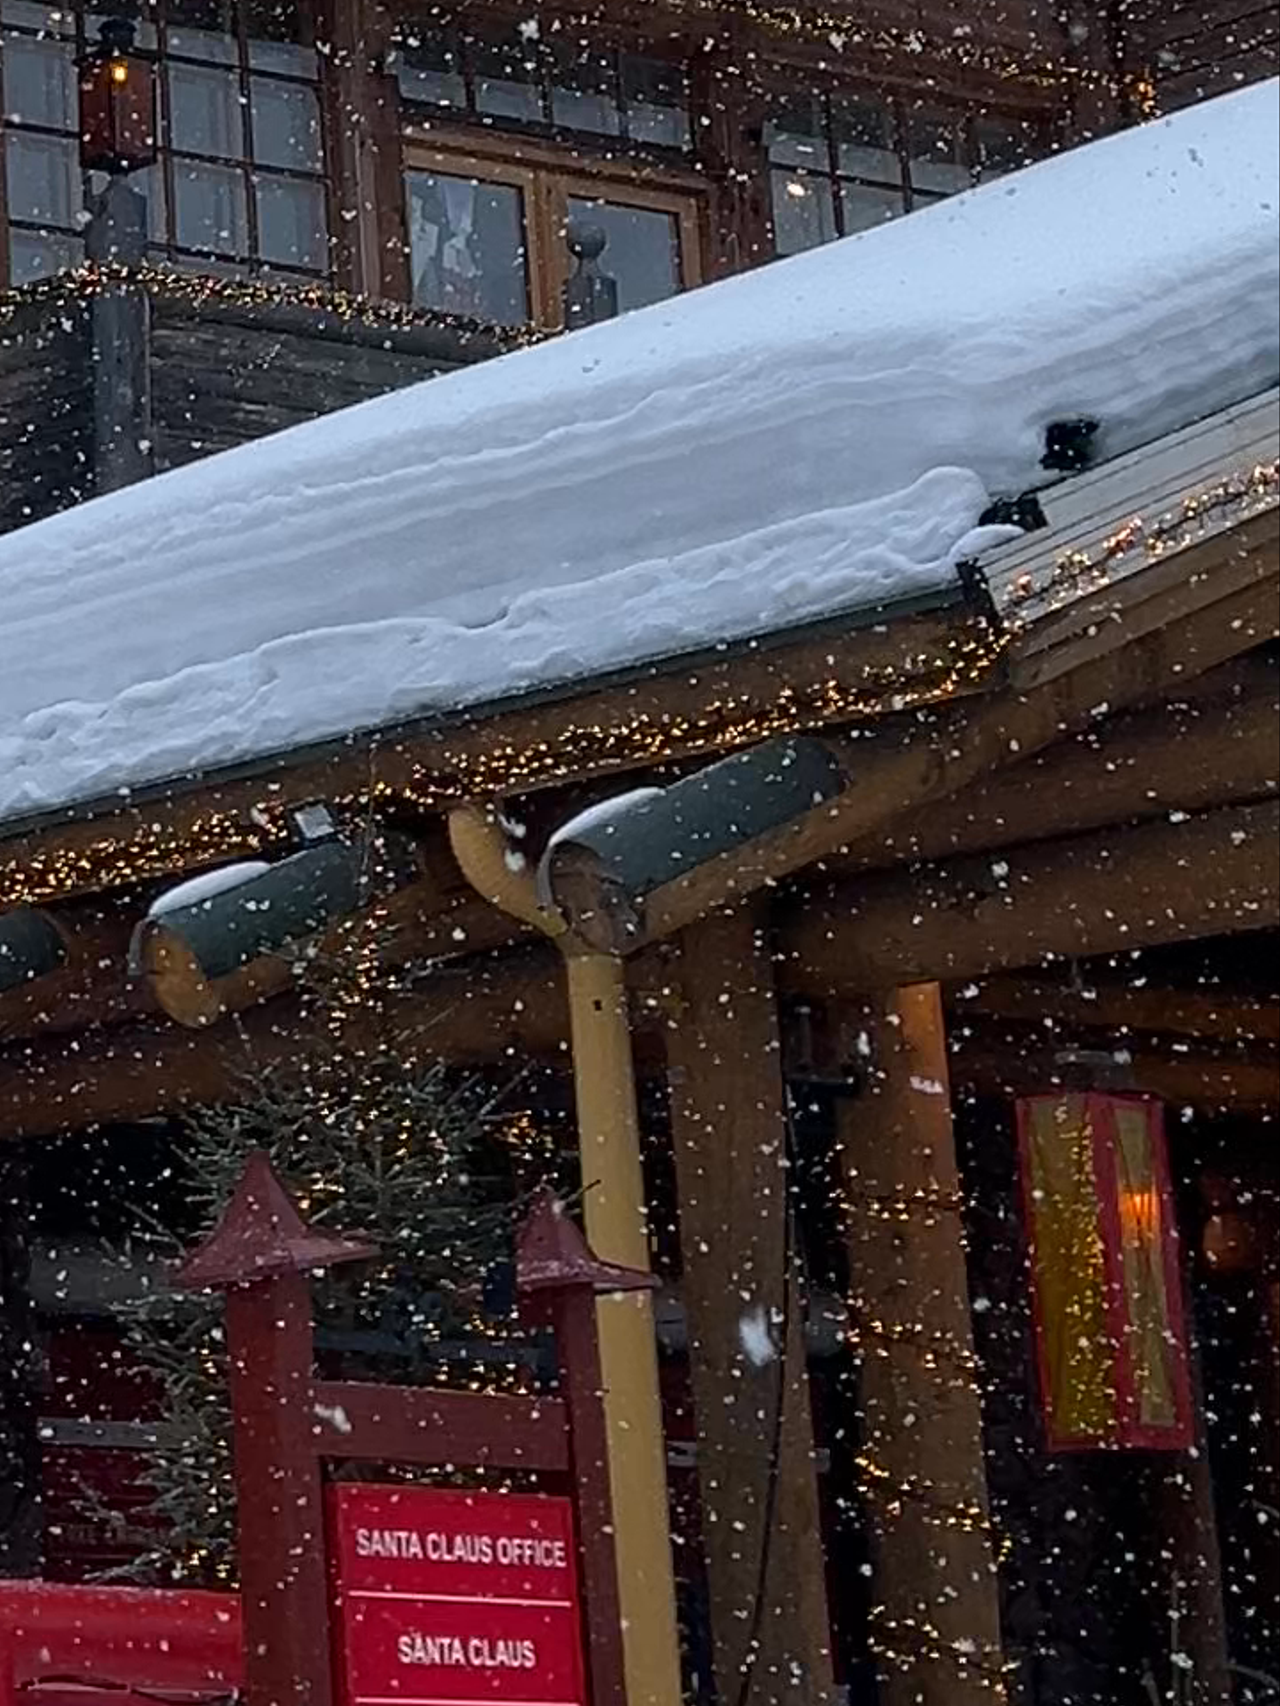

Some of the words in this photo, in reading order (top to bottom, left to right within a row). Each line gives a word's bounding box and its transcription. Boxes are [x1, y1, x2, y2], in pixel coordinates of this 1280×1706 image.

[355, 1528, 423, 1560] SANTA
[425, 1533, 493, 1565] CLAUS
[496, 1537, 567, 1569] OFFICE
[397, 1635, 466, 1666] SANTA
[468, 1639, 537, 1669] CLAUS
